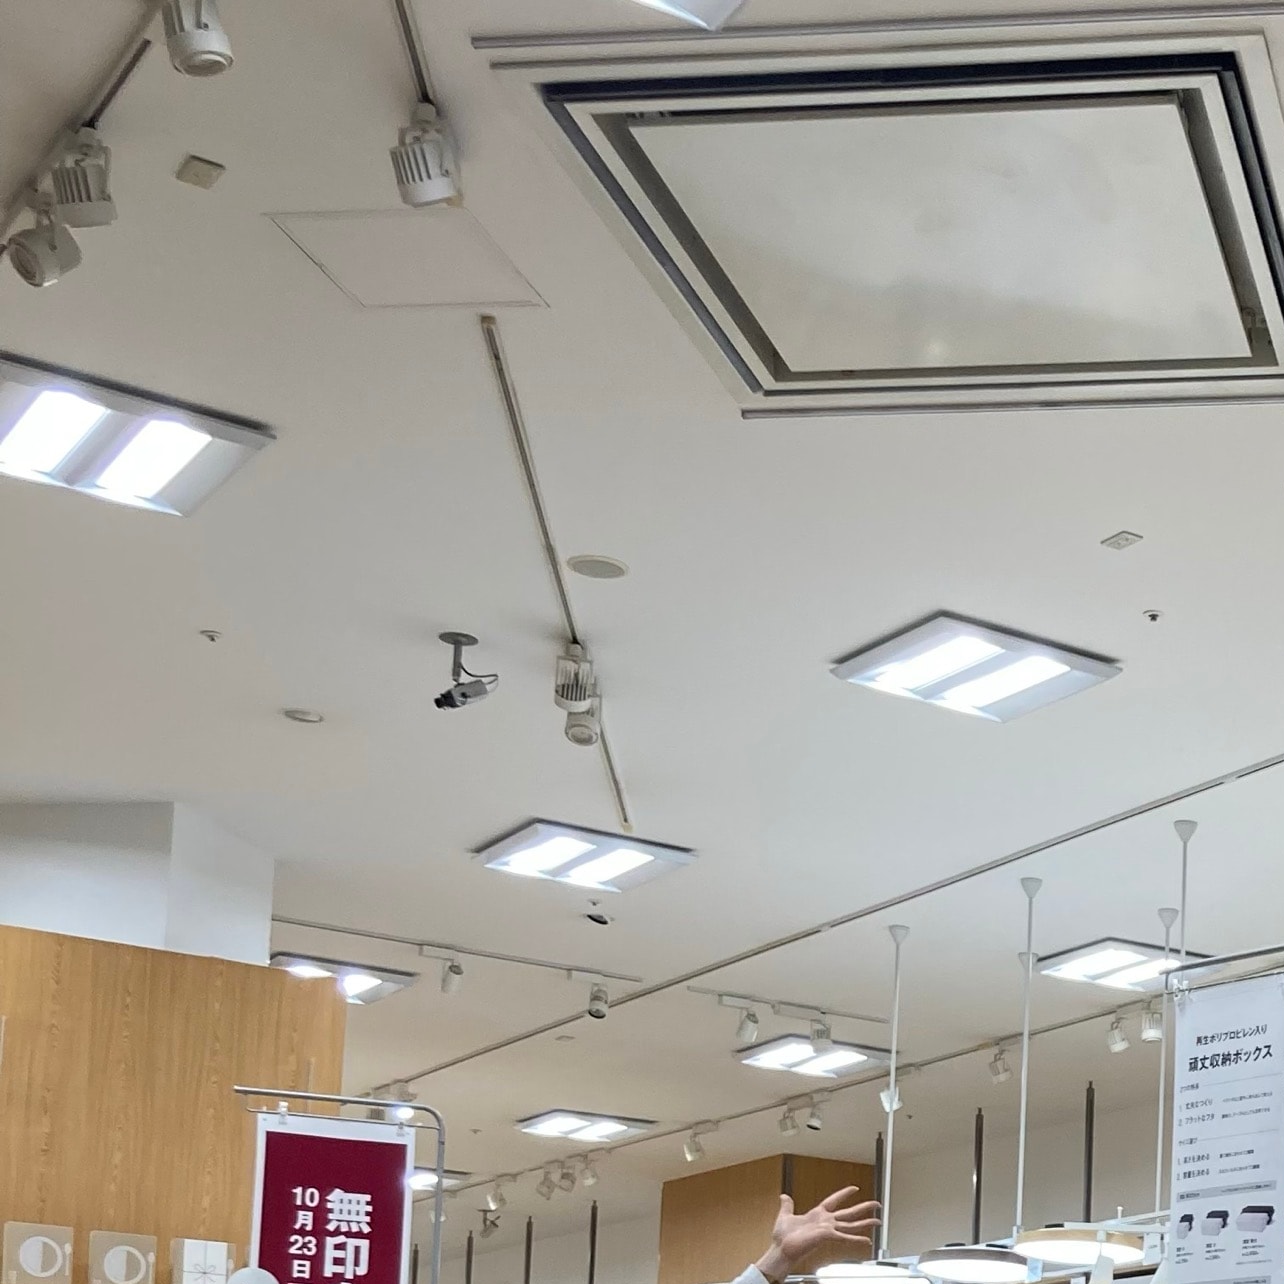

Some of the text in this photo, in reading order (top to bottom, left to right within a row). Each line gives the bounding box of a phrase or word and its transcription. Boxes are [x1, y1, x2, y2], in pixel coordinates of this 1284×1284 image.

[1196, 1024, 1268, 1046] 再生ポリプロピレン入り
[1188, 1045, 1273, 1072] 頑丈収納ボックス
